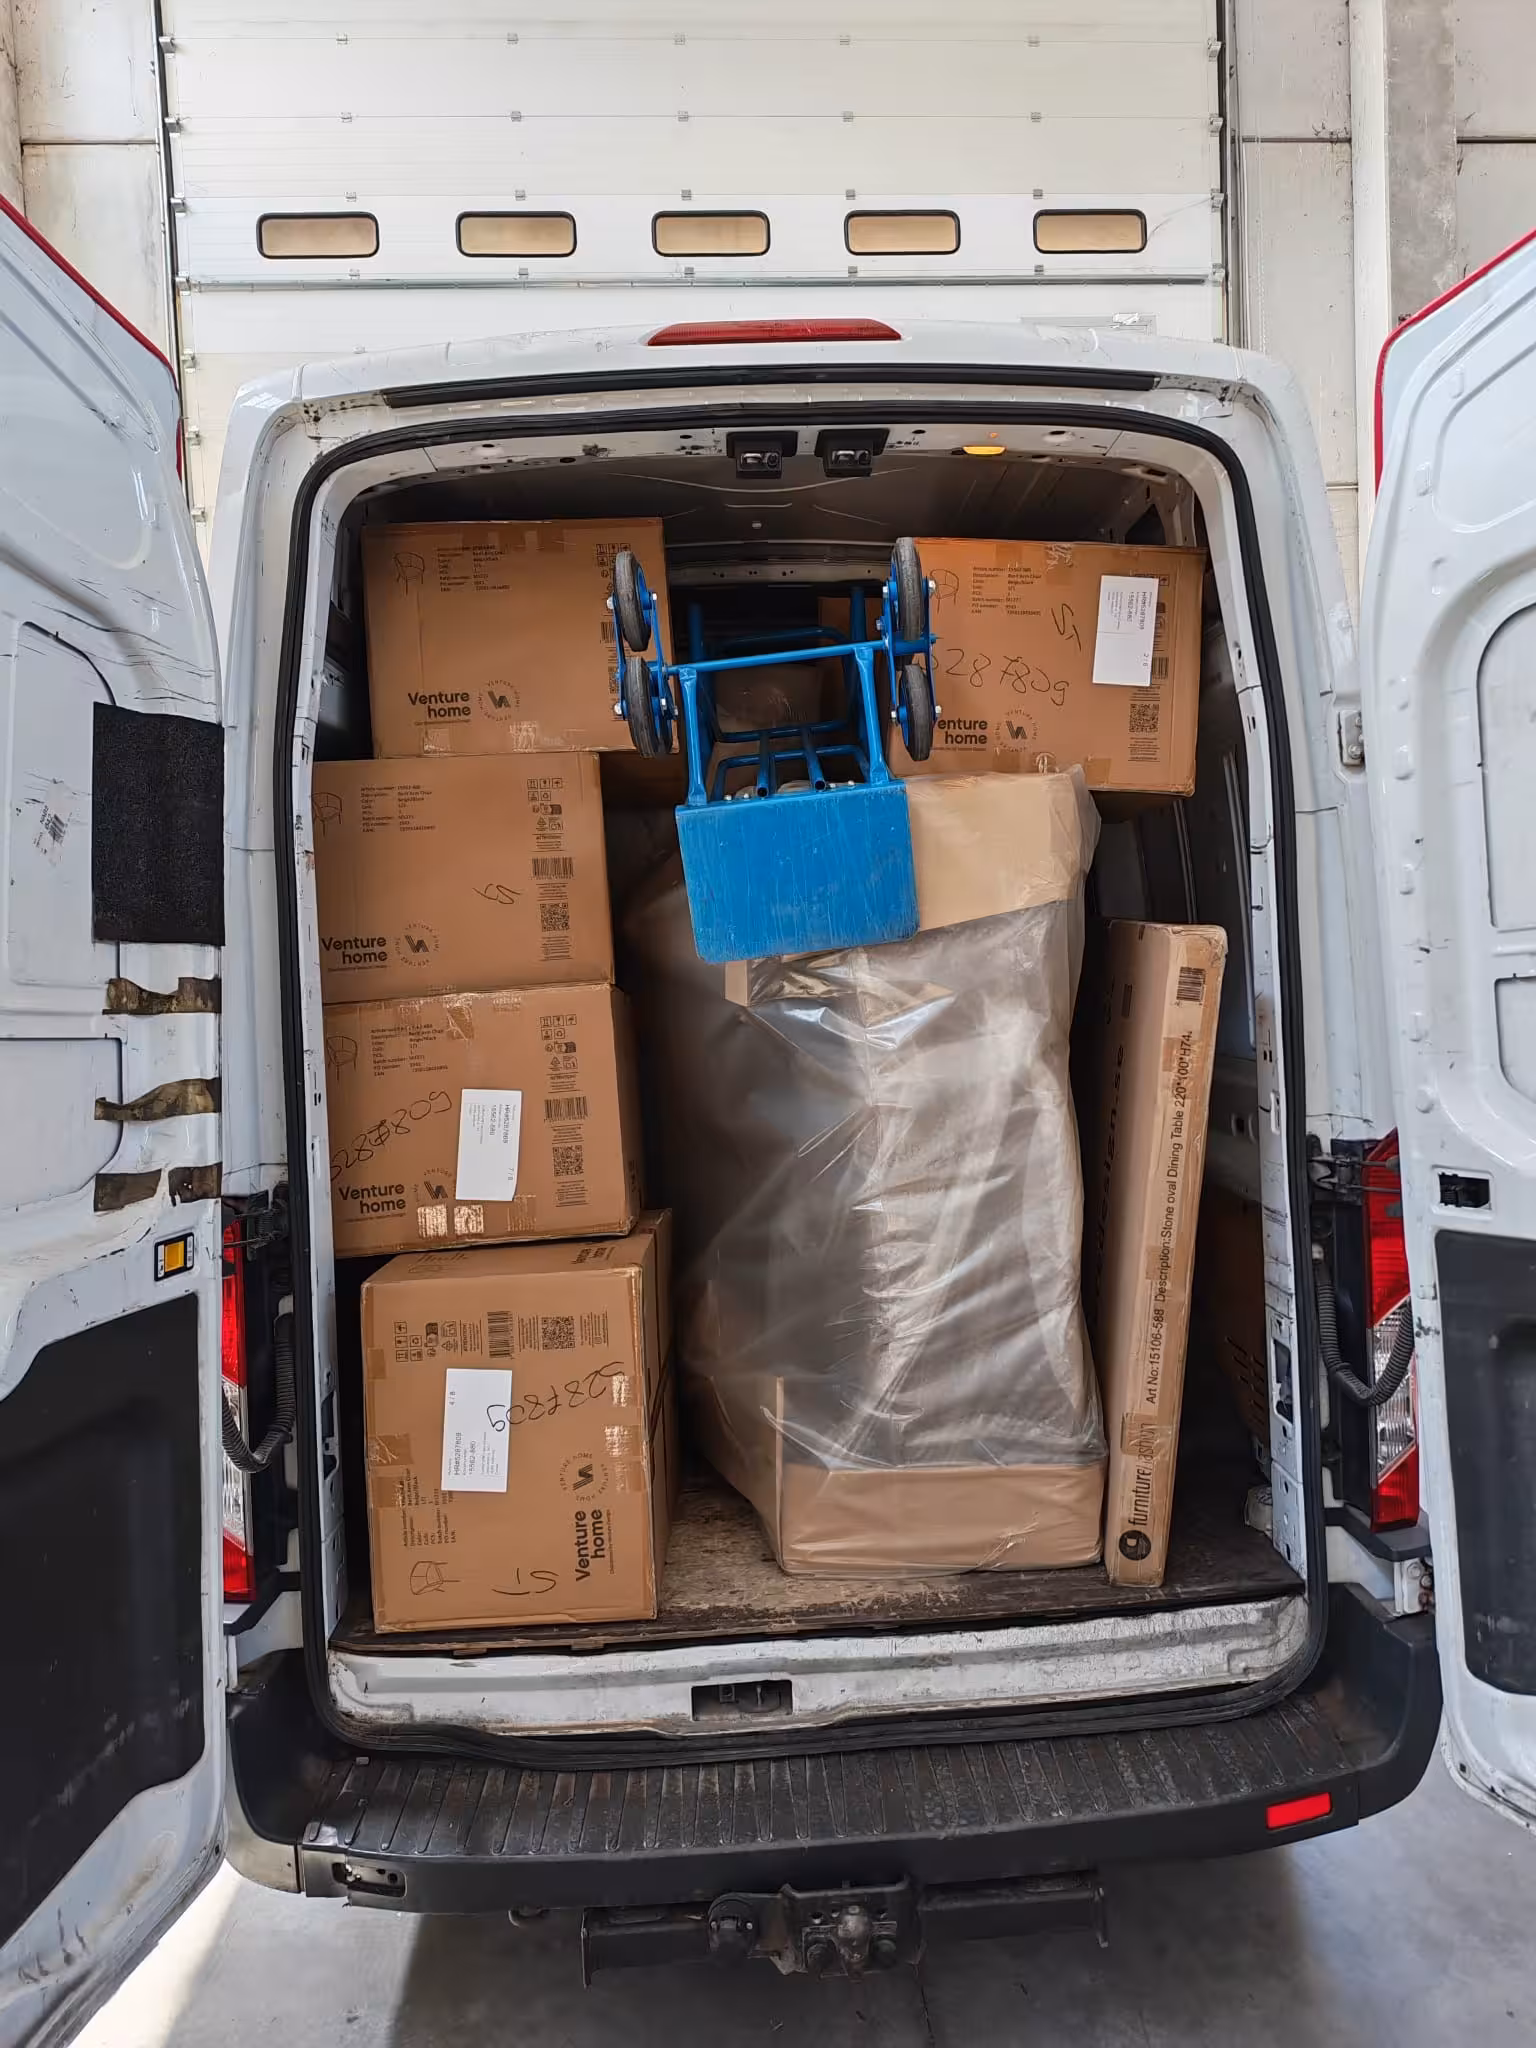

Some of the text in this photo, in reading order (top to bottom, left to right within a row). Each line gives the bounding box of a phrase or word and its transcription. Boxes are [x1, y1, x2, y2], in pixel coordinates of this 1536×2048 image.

[408, 691, 470, 706] Venture
[427, 705, 471, 719] home
[934, 718, 988, 731] enture
[944, 731, 988, 745] home
[321, 936, 387, 951] Venture
[342, 950, 388, 965] home
[1171, 1110, 1184, 1140] Table
[1167, 1142, 1183, 1179] Dining
[338, 1183, 405, 1200] Venture
[1166, 1181, 1177, 1204] oval
[360, 1198, 406, 1214] home
[1147, 1309, 1165, 1386] No:15106-588
[1146, 1388, 1157, 1404] Art
[590, 1509, 605, 1559] home
[574, 1510, 591, 1582] Venture
